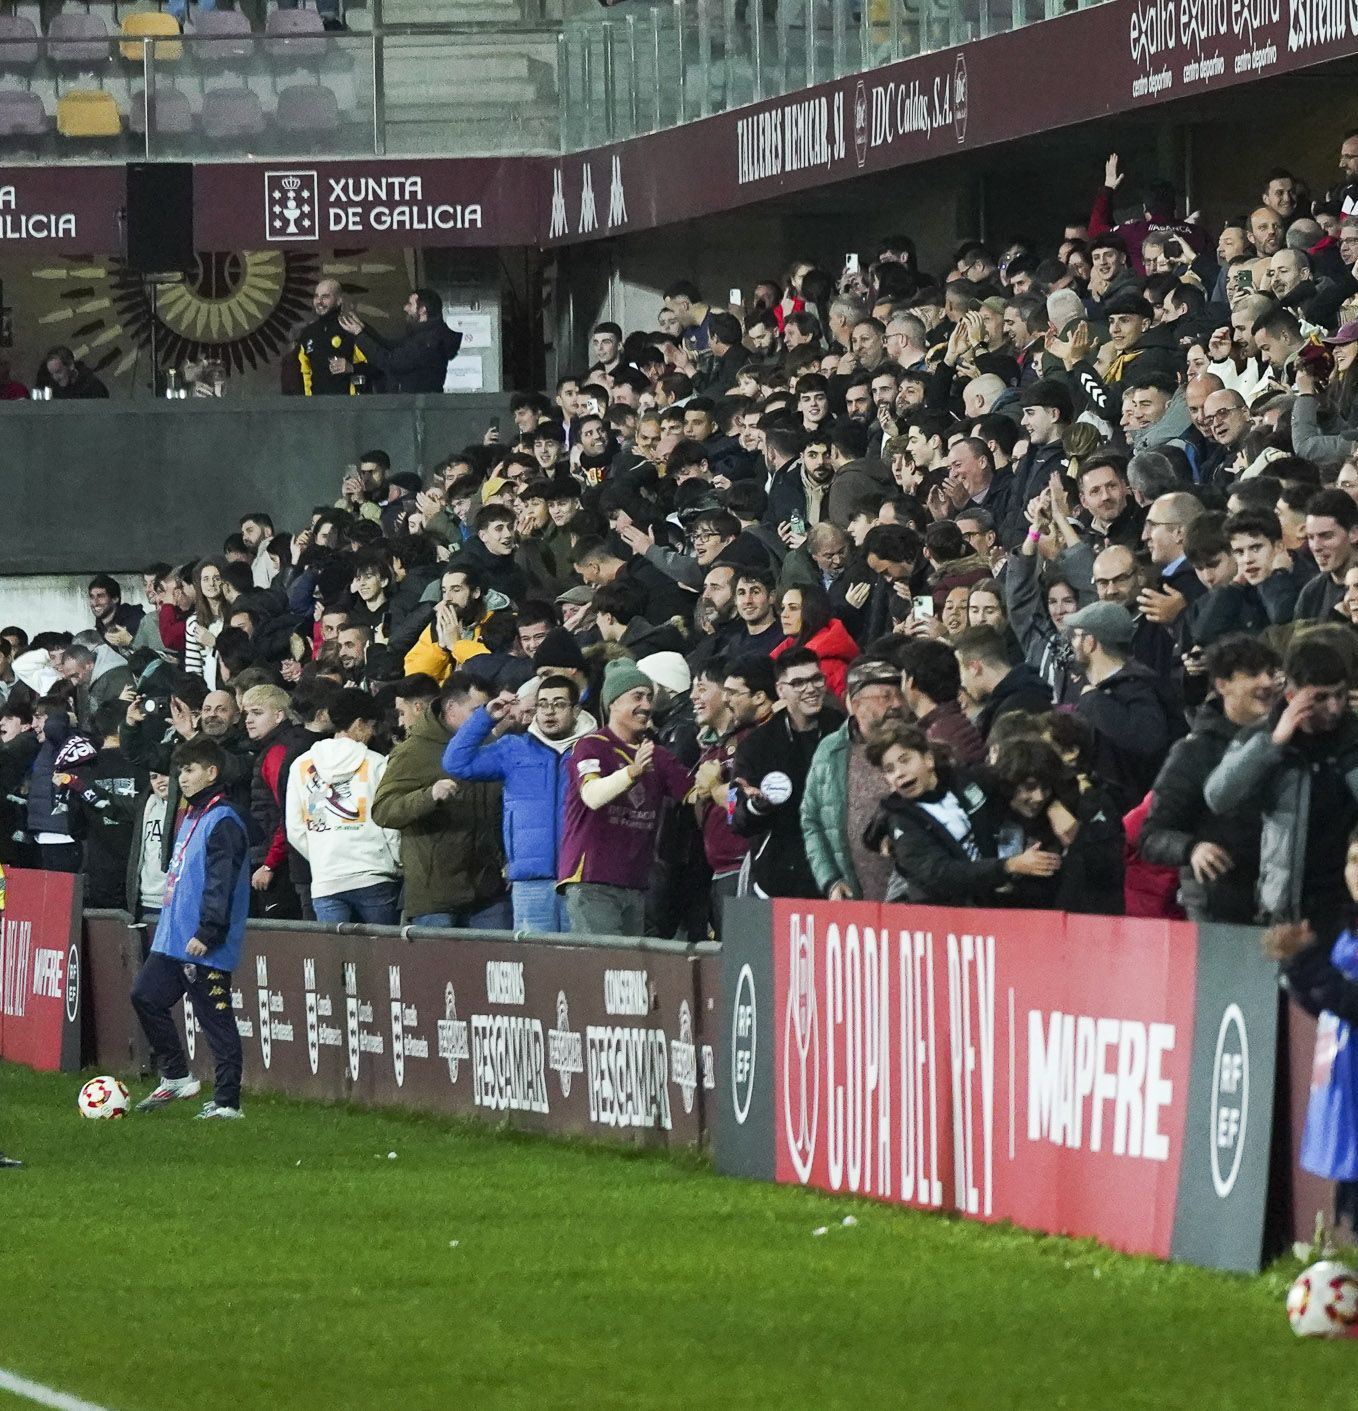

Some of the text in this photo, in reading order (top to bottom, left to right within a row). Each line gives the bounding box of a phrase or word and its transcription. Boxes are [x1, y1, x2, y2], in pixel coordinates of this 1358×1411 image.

[737, 107, 782, 185] TALLERES
[833, 91, 846, 161] SL
[870, 82, 895, 147] IDC
[0, 214, 77, 239] LICIA
[328, 177, 423, 202] XUNTA
[328, 203, 483, 232] DE GALICIA
[471, 1014, 549, 1114] PESCAMAR
[587, 1025, 672, 1130] PESCAMAR
[826, 923, 996, 1217] COPA DEL REY
[1027, 1009, 1175, 1161] MAPFRE
